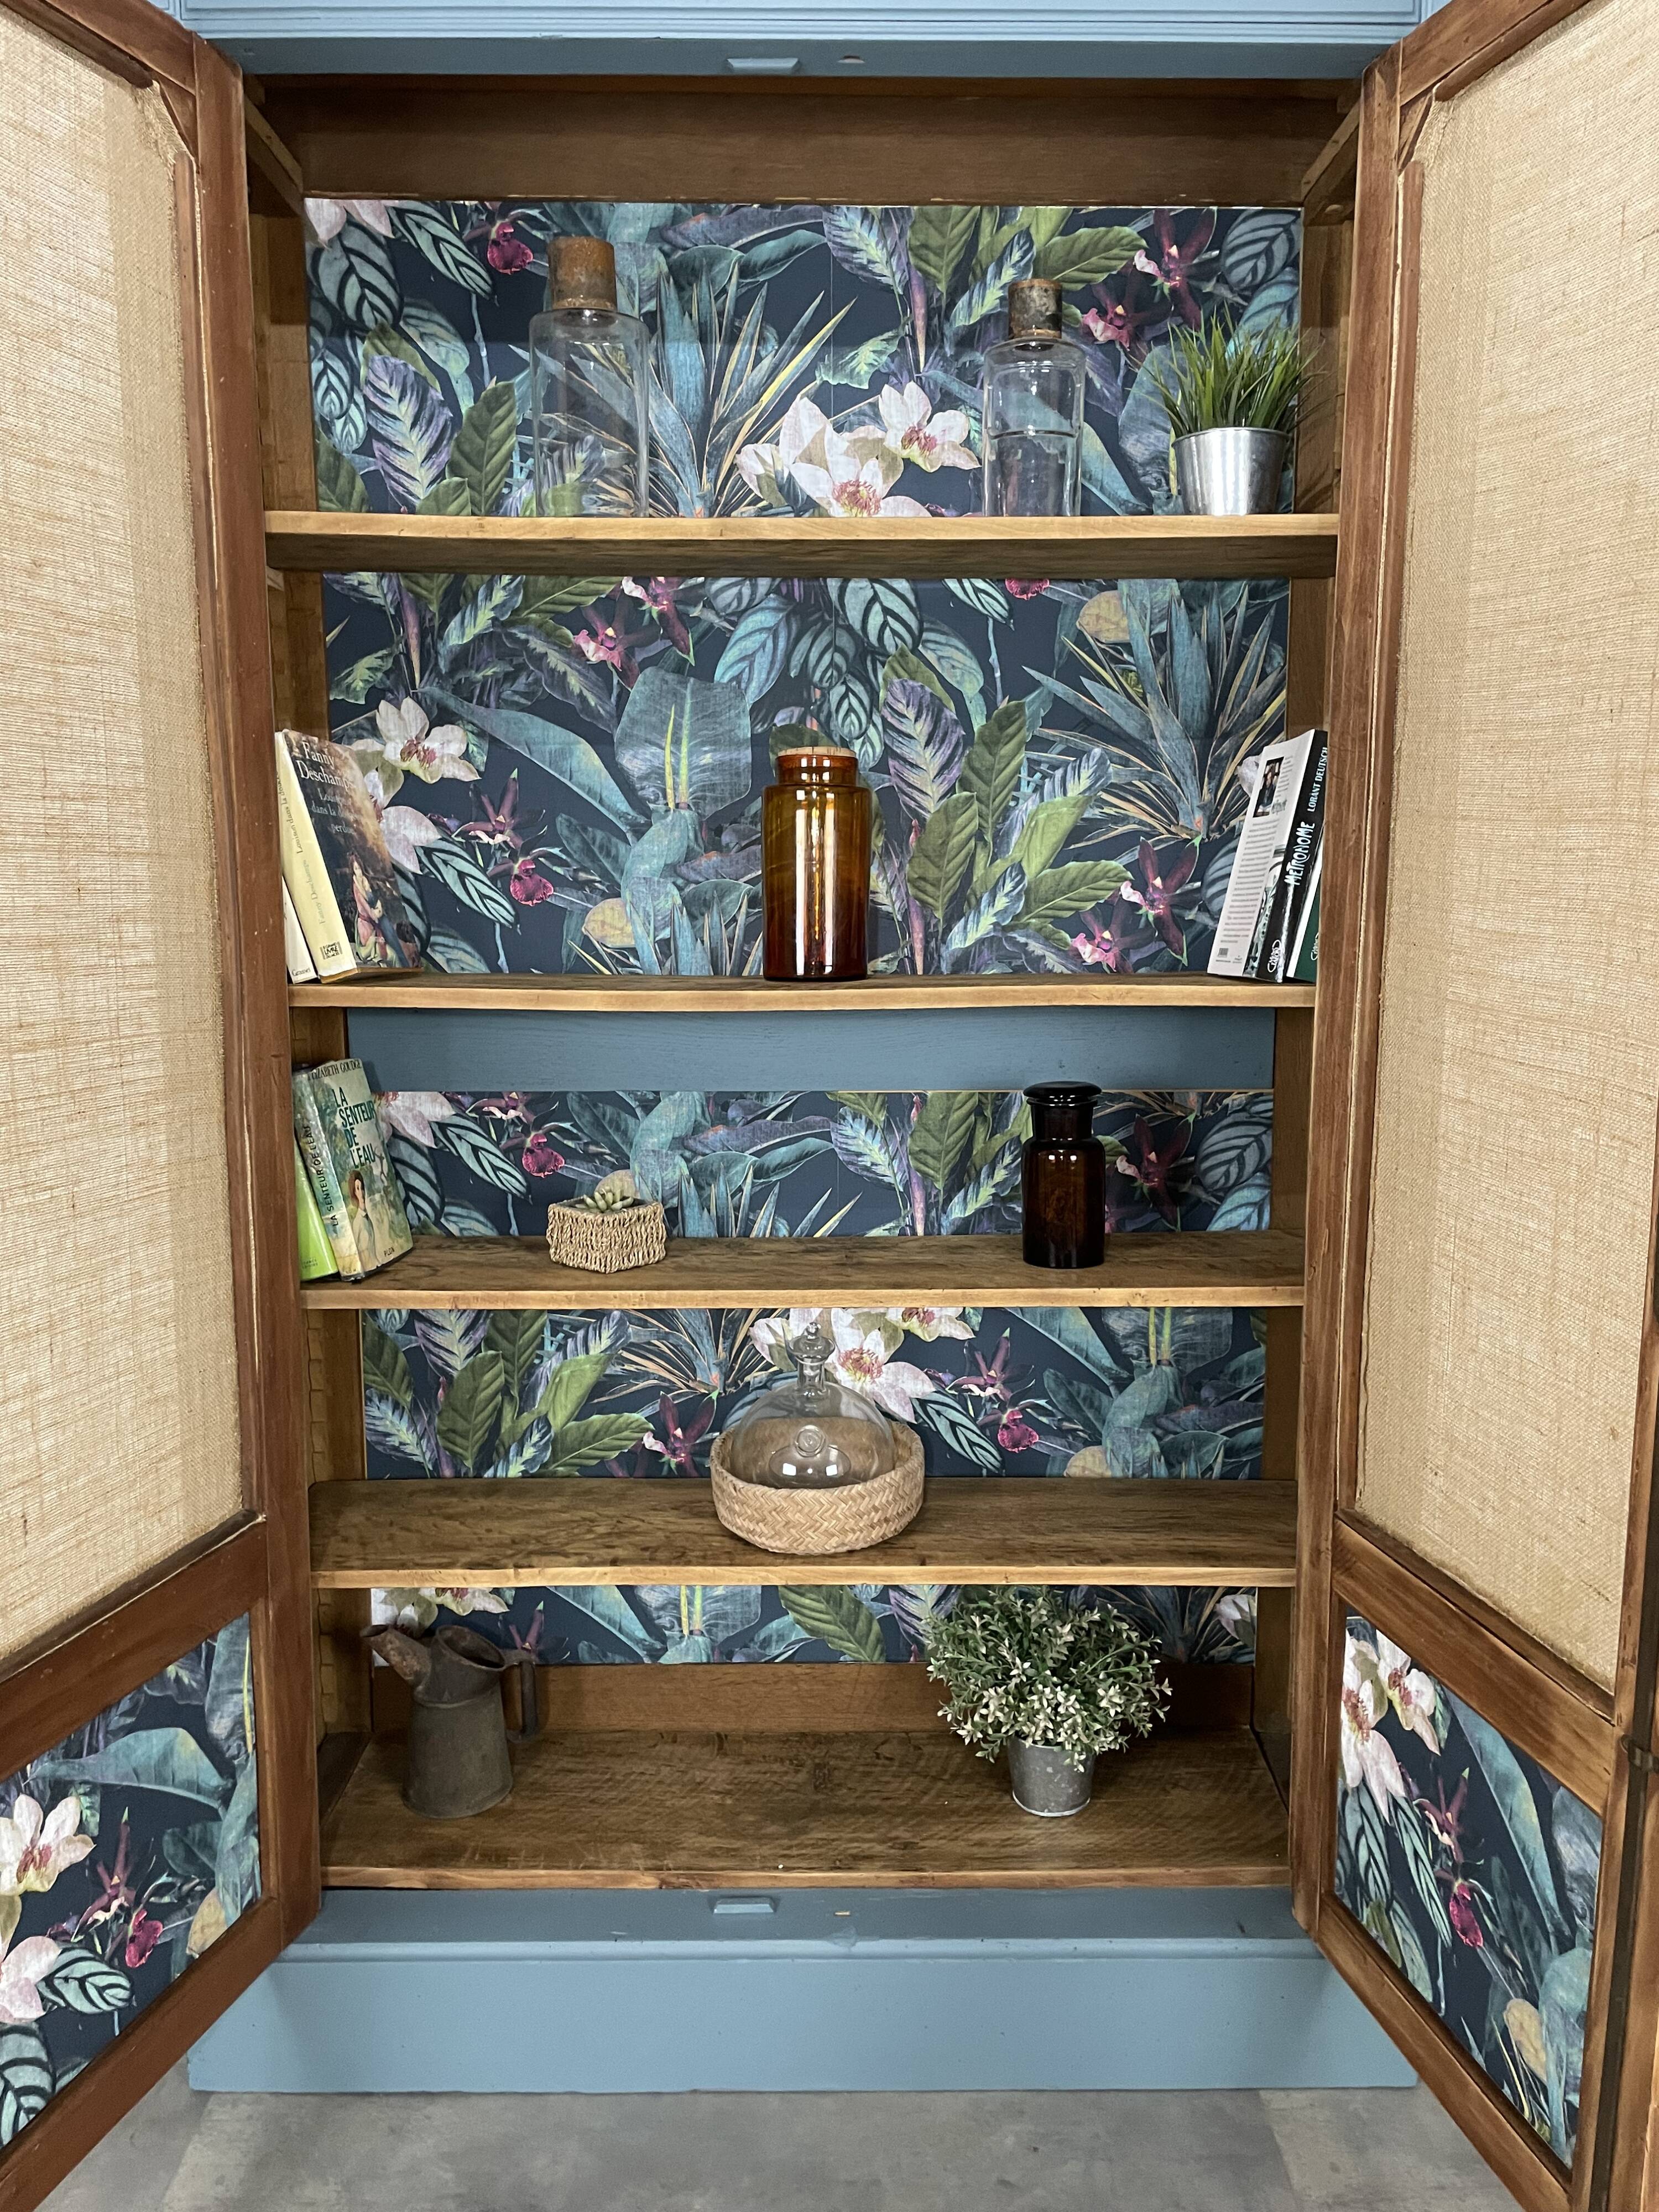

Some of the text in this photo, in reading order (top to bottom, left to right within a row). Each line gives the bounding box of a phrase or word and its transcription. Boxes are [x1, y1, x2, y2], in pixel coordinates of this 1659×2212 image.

[302, 741, 335, 770] Fanny
[1314, 747, 1328, 782] DEUTSCH
[296, 760, 354, 792] Deschamps
[1284, 821, 1315, 885] METRONOME
[331, 1086, 348, 1108] LA
[338, 1100, 375, 1128] SENTEUR
[343, 1127, 359, 1149] DE
[311, 1152, 322, 1166] DE
[349, 1142, 376, 1169] L'EAU
[316, 1168, 335, 1213] SENTEUR
[330, 1214, 339, 1227] LA
